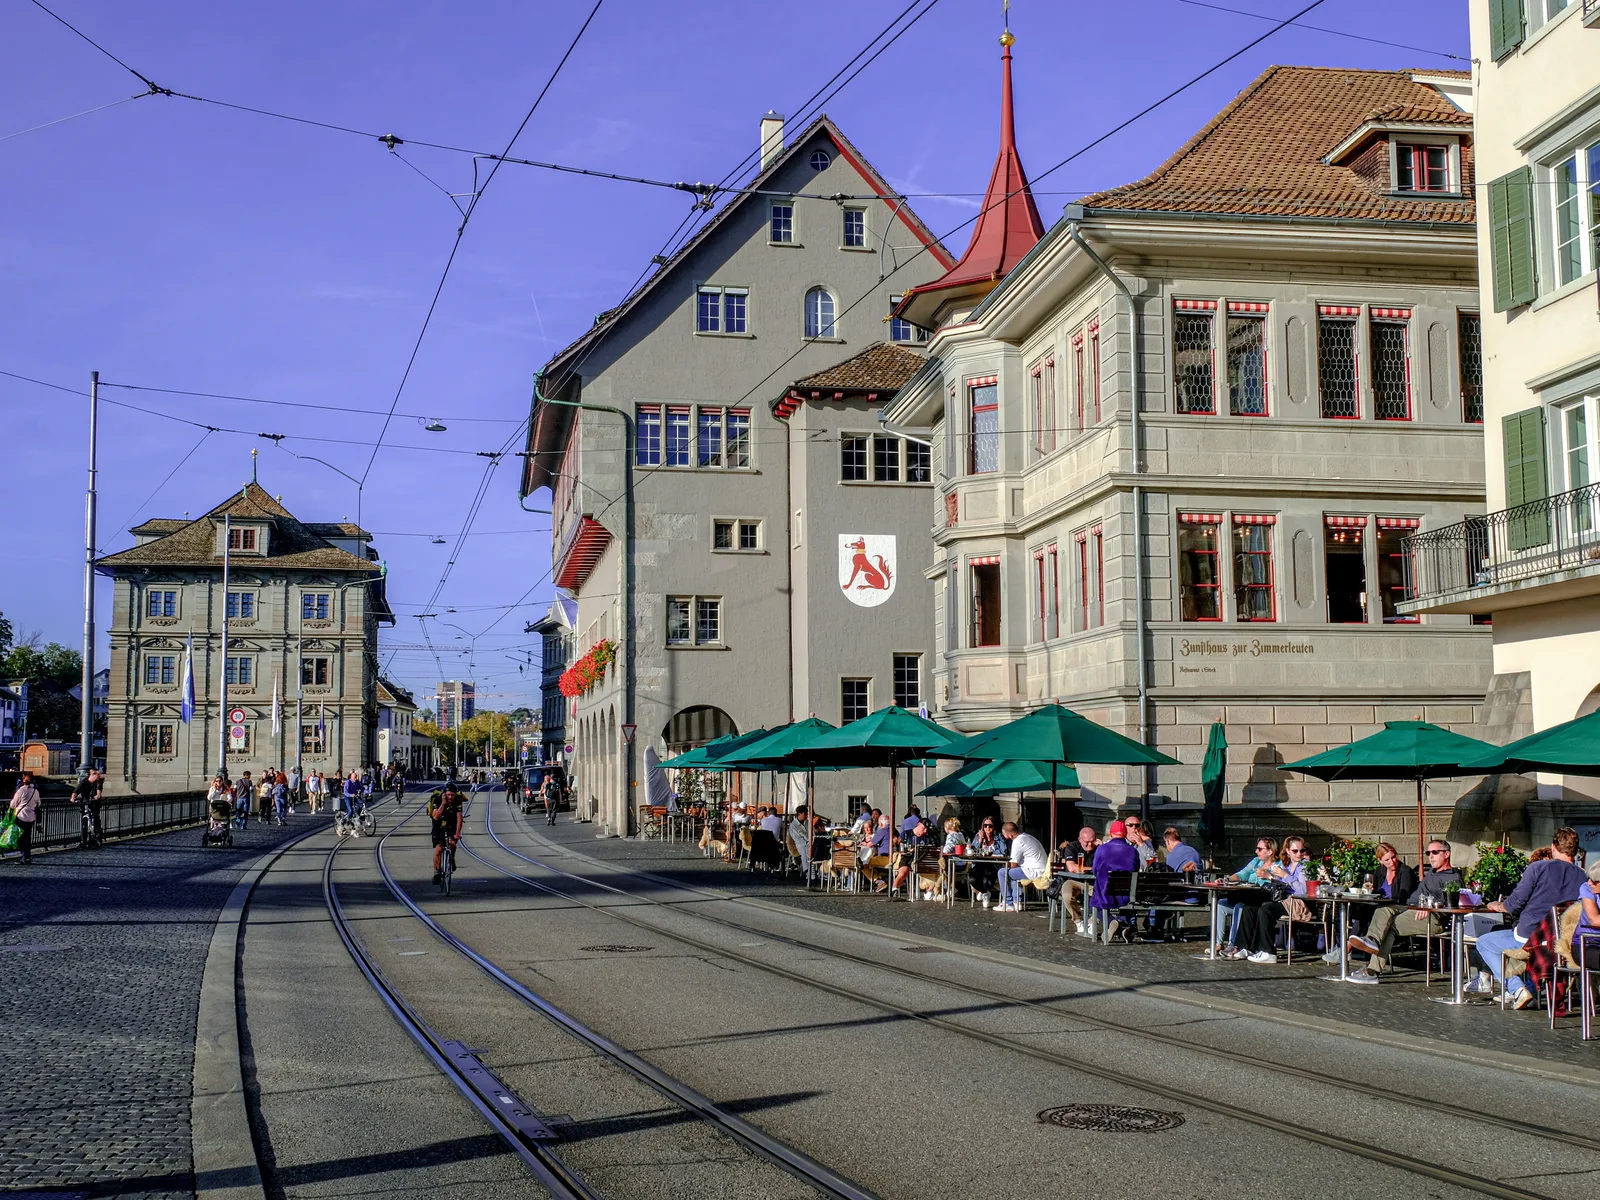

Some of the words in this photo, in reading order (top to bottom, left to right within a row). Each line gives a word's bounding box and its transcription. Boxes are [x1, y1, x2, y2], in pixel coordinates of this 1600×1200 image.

[1179, 638, 1228, 657] Zunfthaus
[1231, 644, 1248, 657] zur
[1249, 638, 1315, 657] Zimmerleuten
